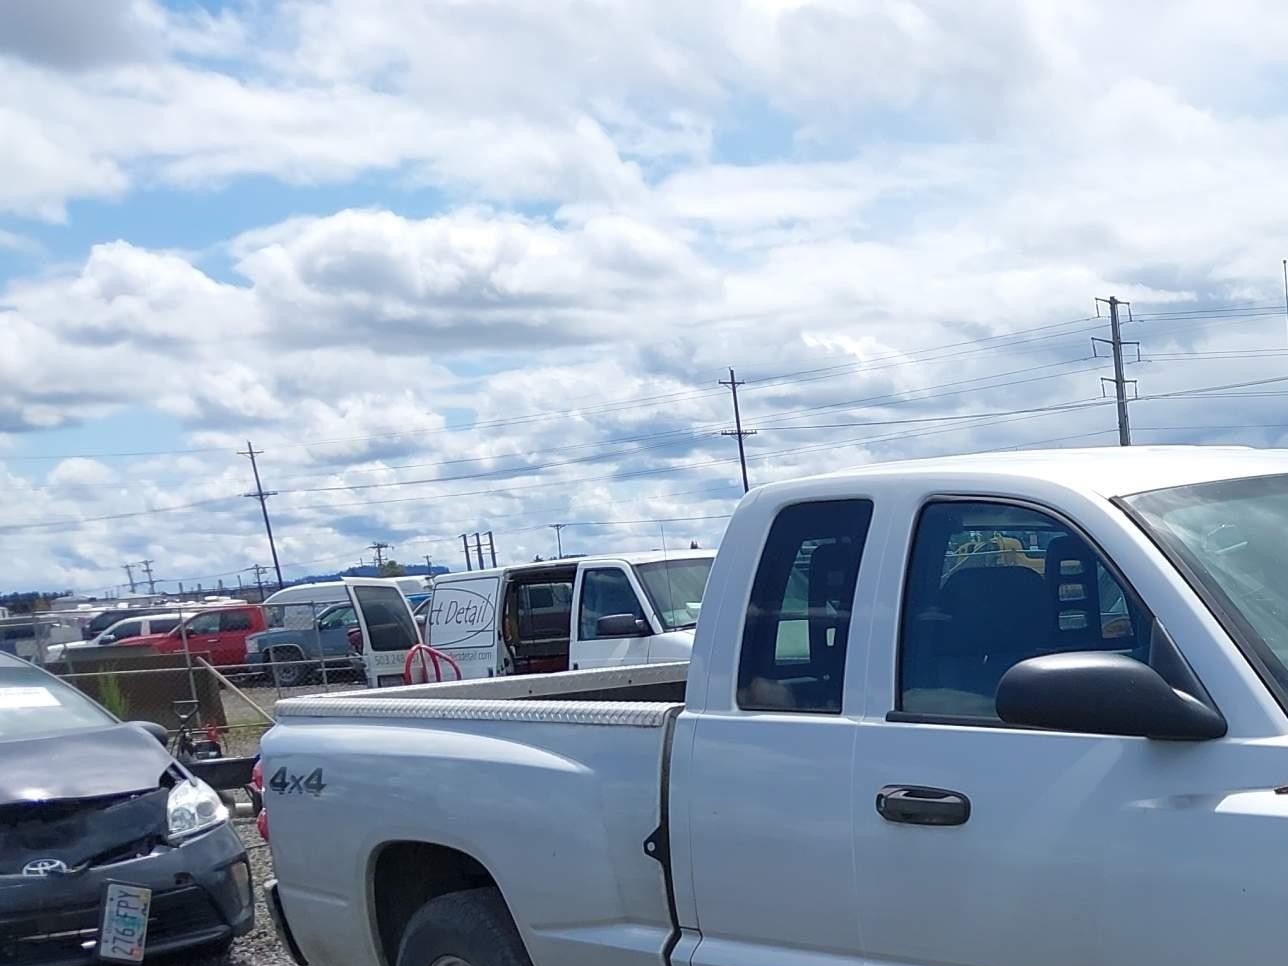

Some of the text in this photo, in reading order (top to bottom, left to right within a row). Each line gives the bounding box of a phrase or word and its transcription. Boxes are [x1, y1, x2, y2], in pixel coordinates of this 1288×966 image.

[444, 594, 491, 626] Detail
[269, 766, 327, 795] 4x4
[111, 890, 140, 957] 276 FPY
